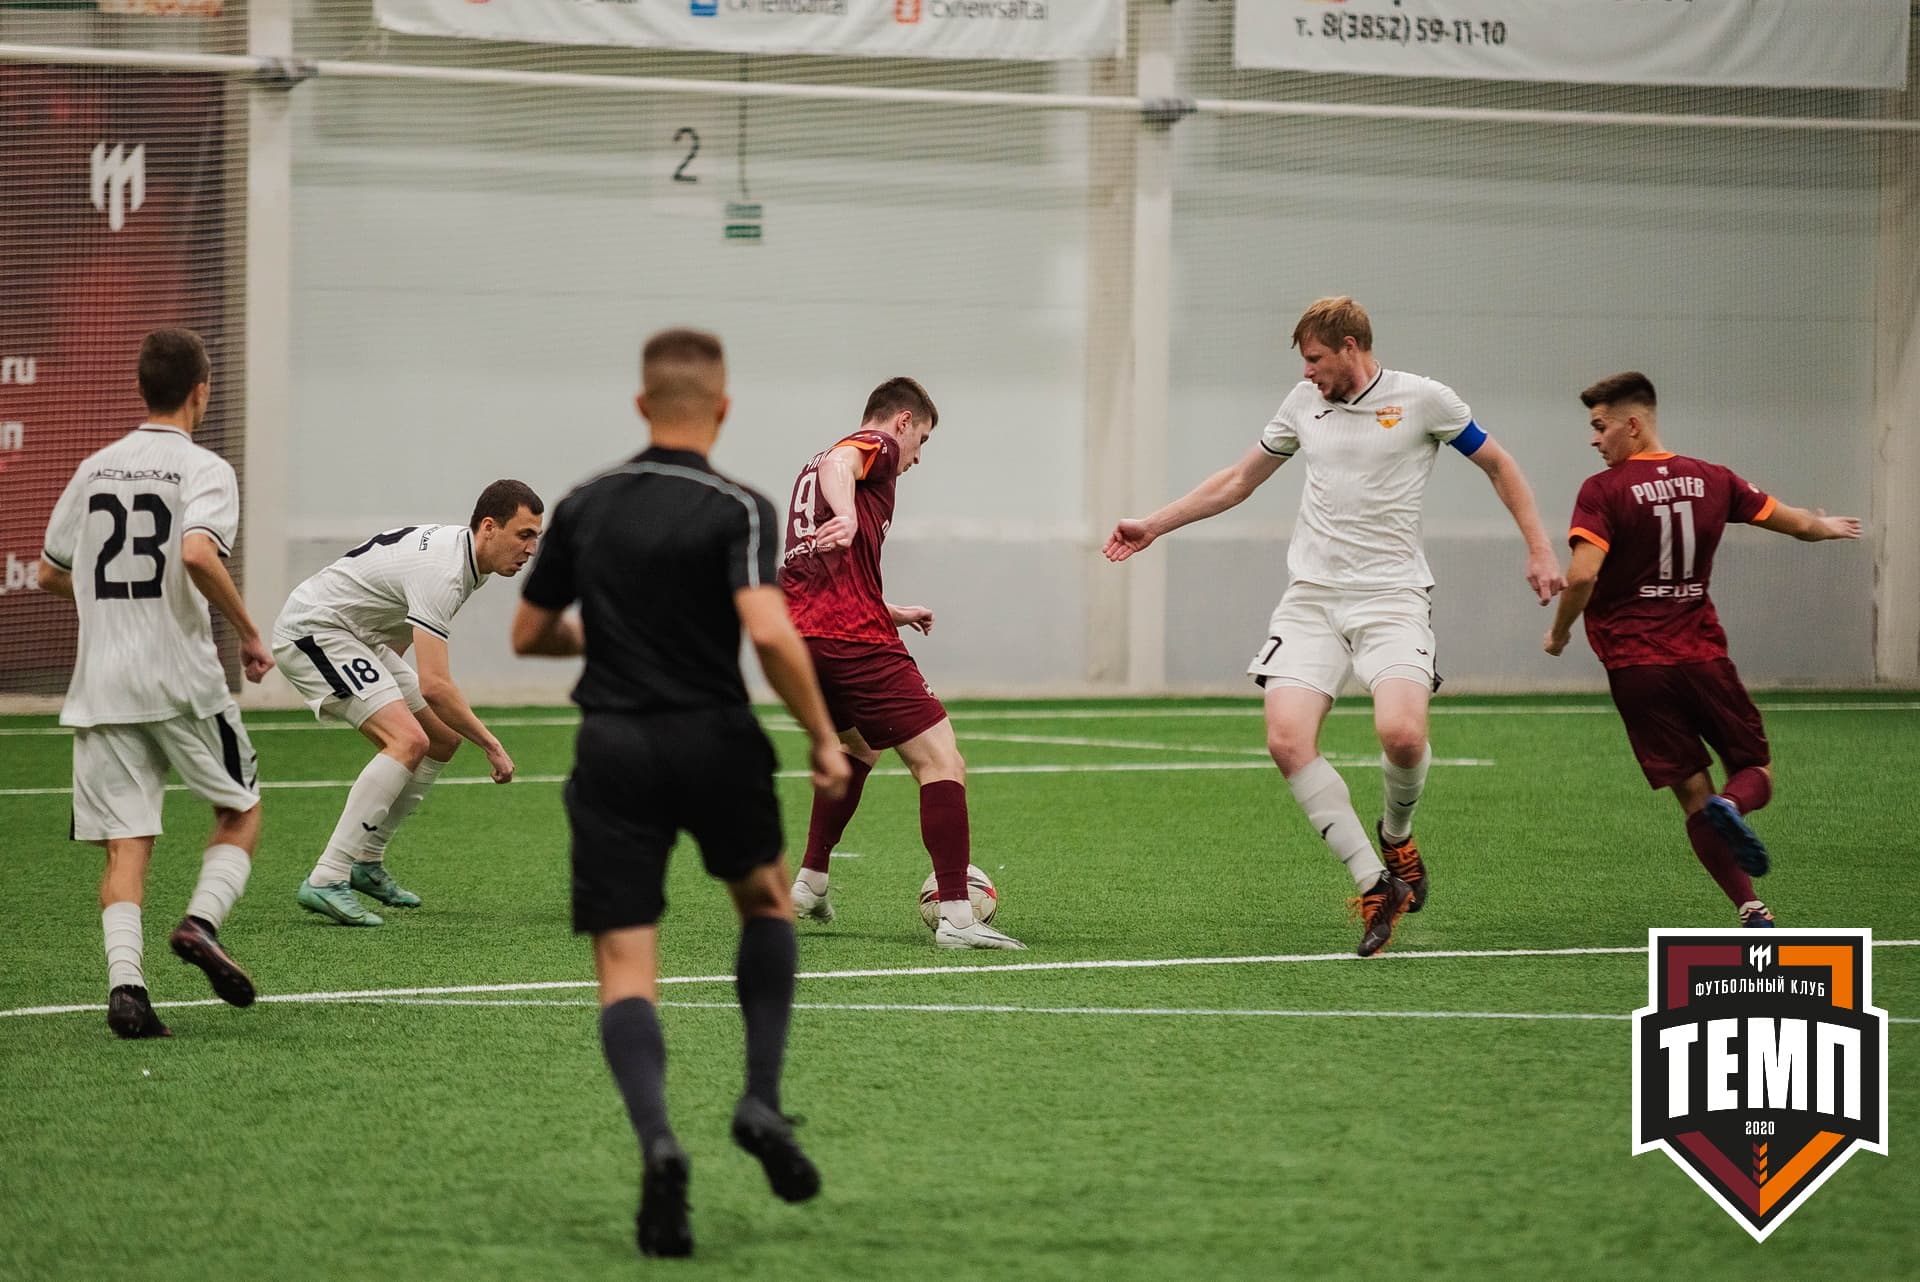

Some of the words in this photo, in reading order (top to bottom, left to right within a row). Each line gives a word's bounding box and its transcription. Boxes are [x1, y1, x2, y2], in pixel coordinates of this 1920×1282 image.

[1322, 12, 1410, 46] 8(3852)
[1416, 16, 1506, 45] 59-11-10
[673, 127, 699, 183] 2
[794, 472, 818, 539] 9
[89, 493, 172, 600] 23
[1653, 501, 1696, 580] 11
[341, 657, 380, 691] 18
